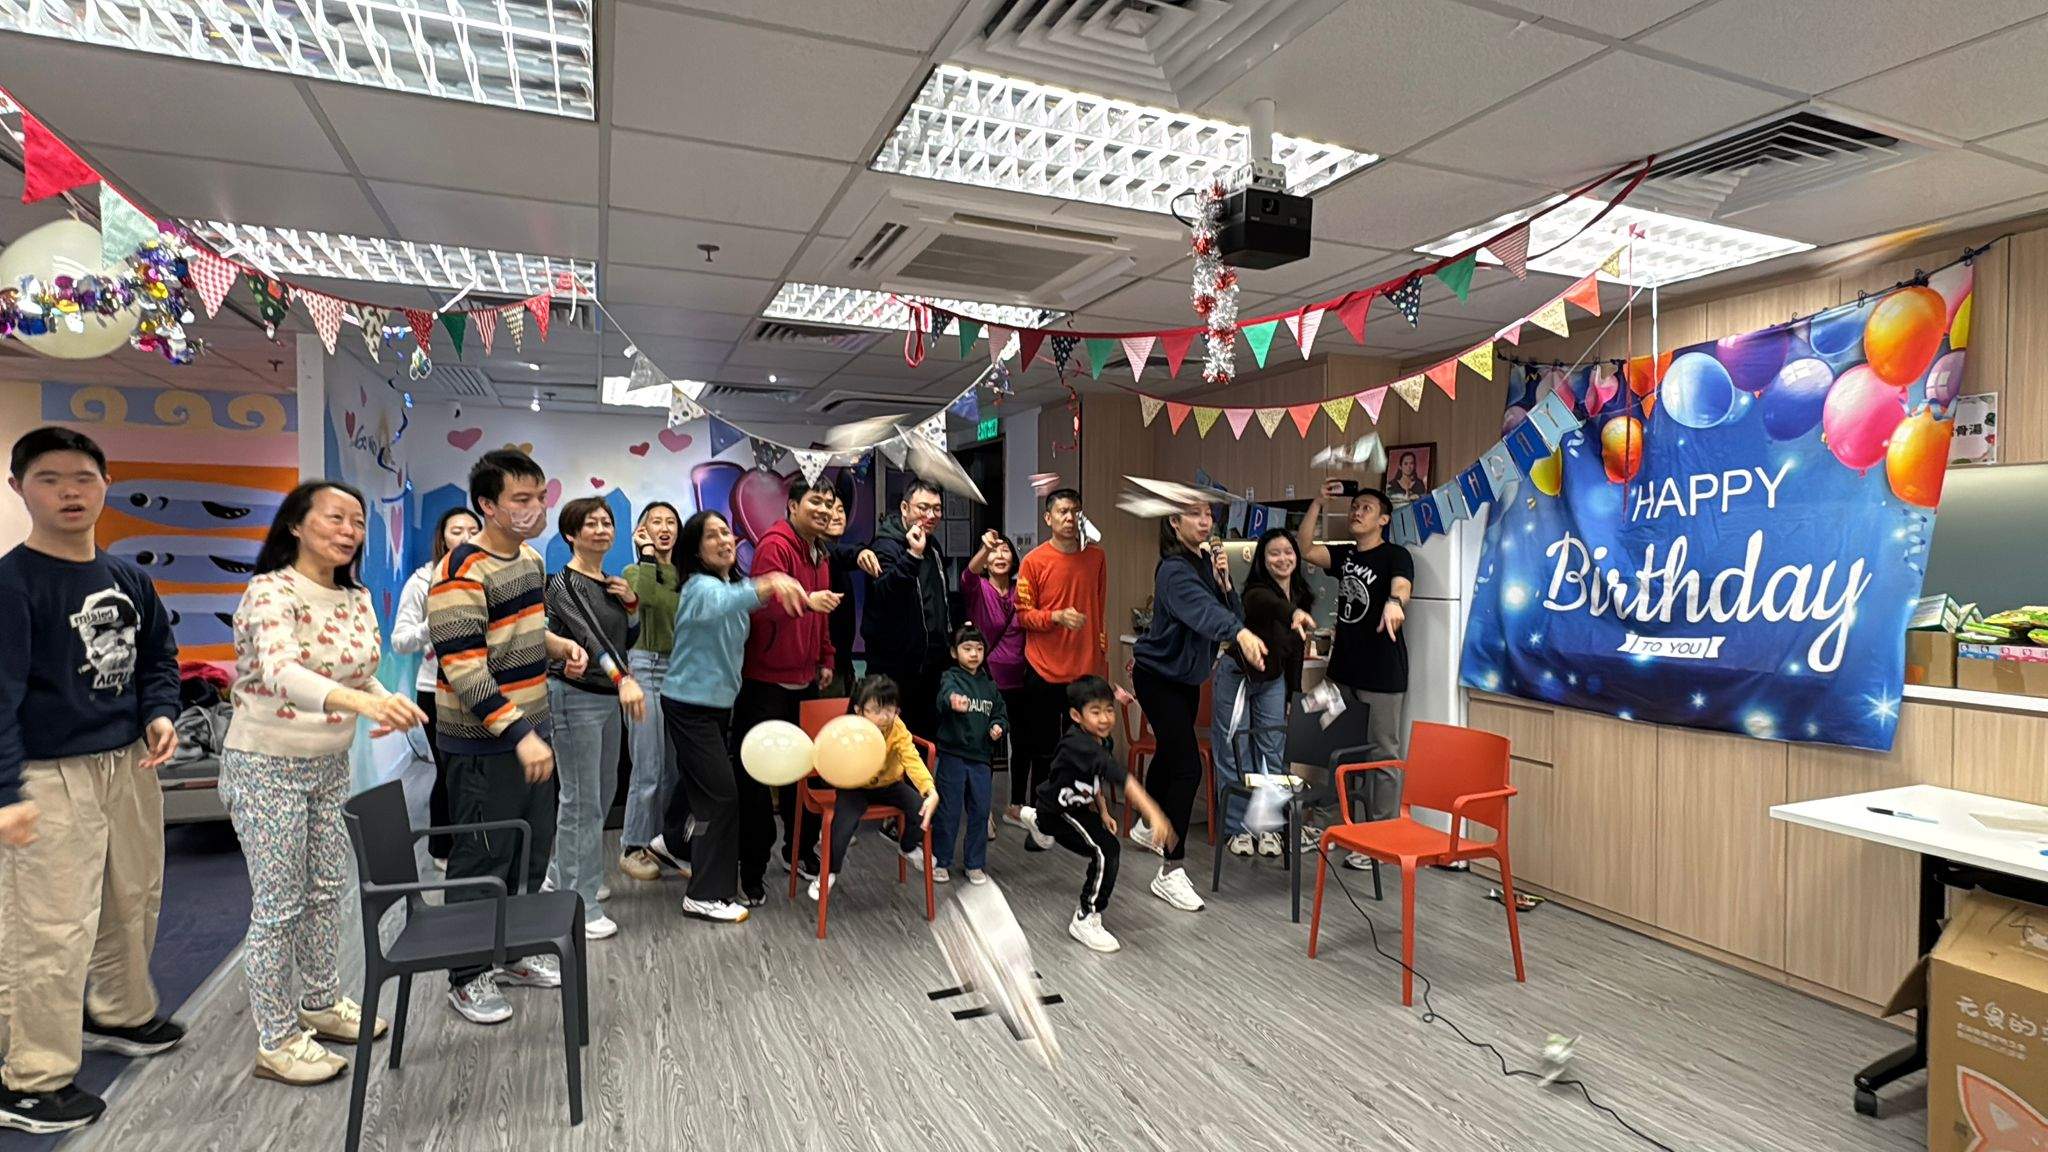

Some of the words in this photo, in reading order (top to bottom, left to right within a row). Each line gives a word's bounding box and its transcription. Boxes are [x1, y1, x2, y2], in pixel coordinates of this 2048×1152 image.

[1951, 422, 1983, 438] 骨湯
[1400, 402, 1559, 537] IRTHDAY
[1631, 460, 1793, 522] HAPPY
[1542, 529, 1872, 673] Birthday
[1642, 640, 1662, 653] TO
[1670, 641, 1703, 655] YOU
